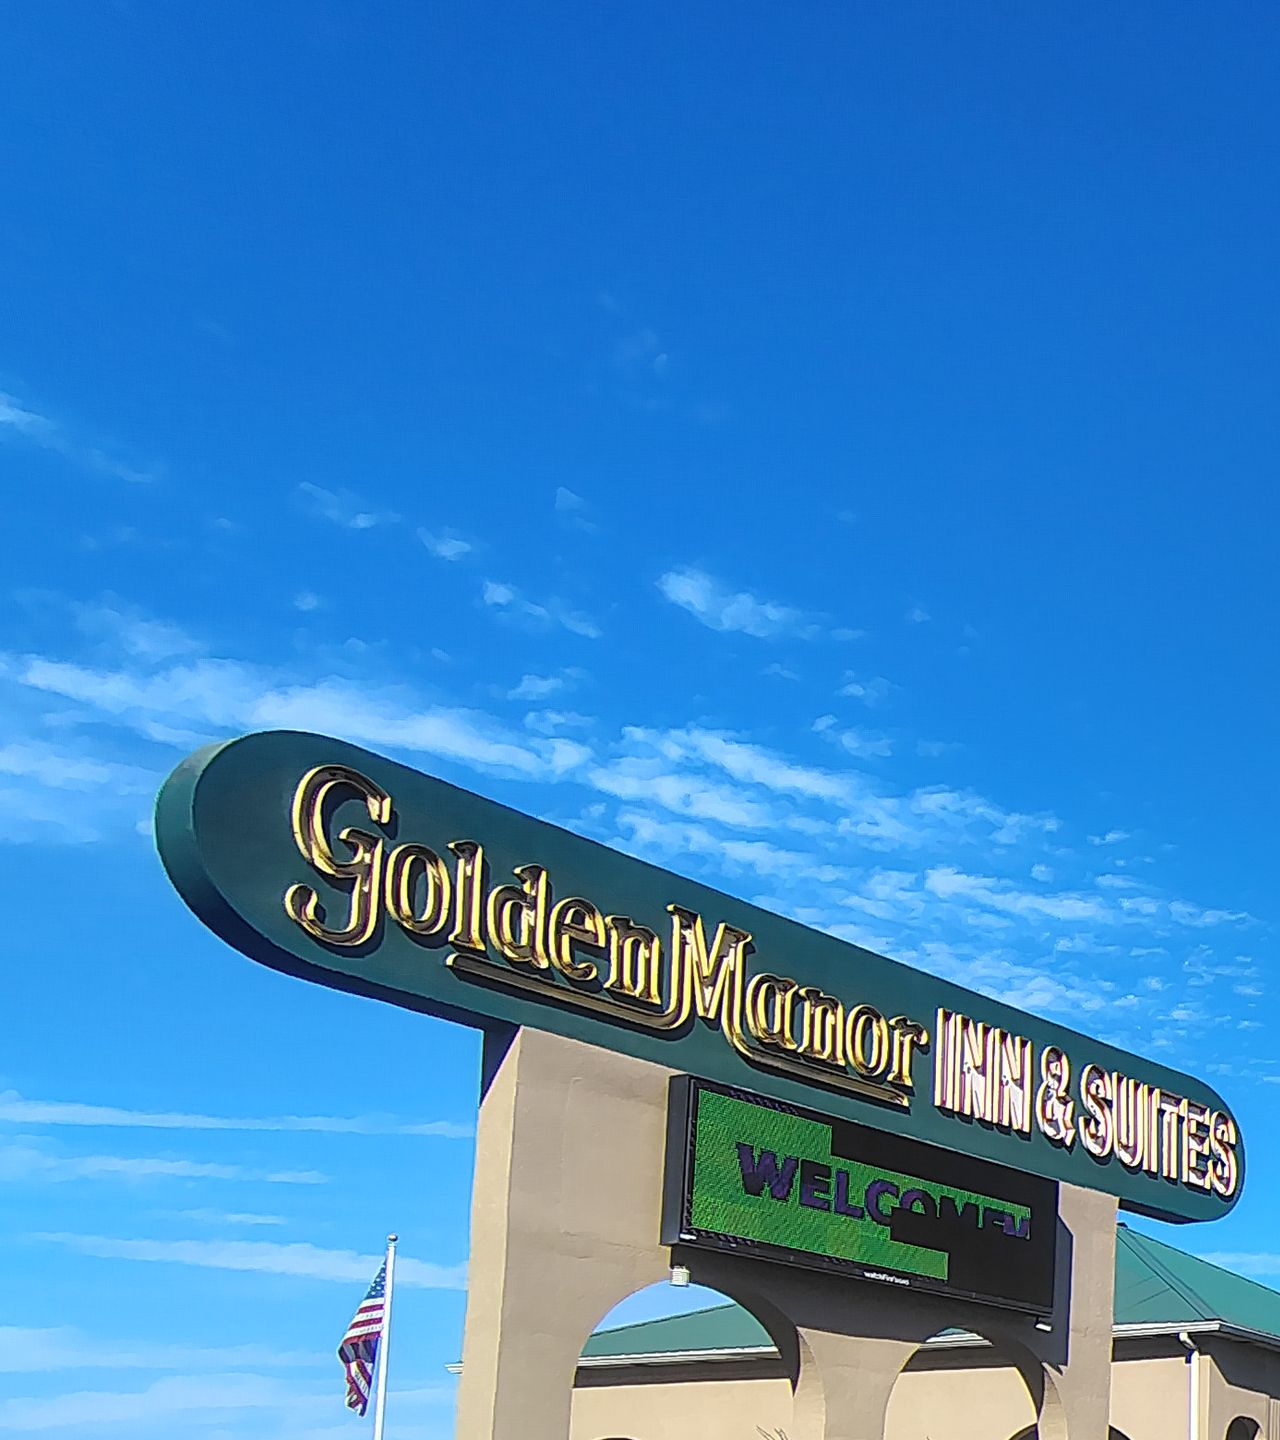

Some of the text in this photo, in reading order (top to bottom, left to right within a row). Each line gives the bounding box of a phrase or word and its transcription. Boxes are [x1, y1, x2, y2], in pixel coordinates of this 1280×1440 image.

[284, 764, 1237, 1196] Golden Manor INN & SUITES
